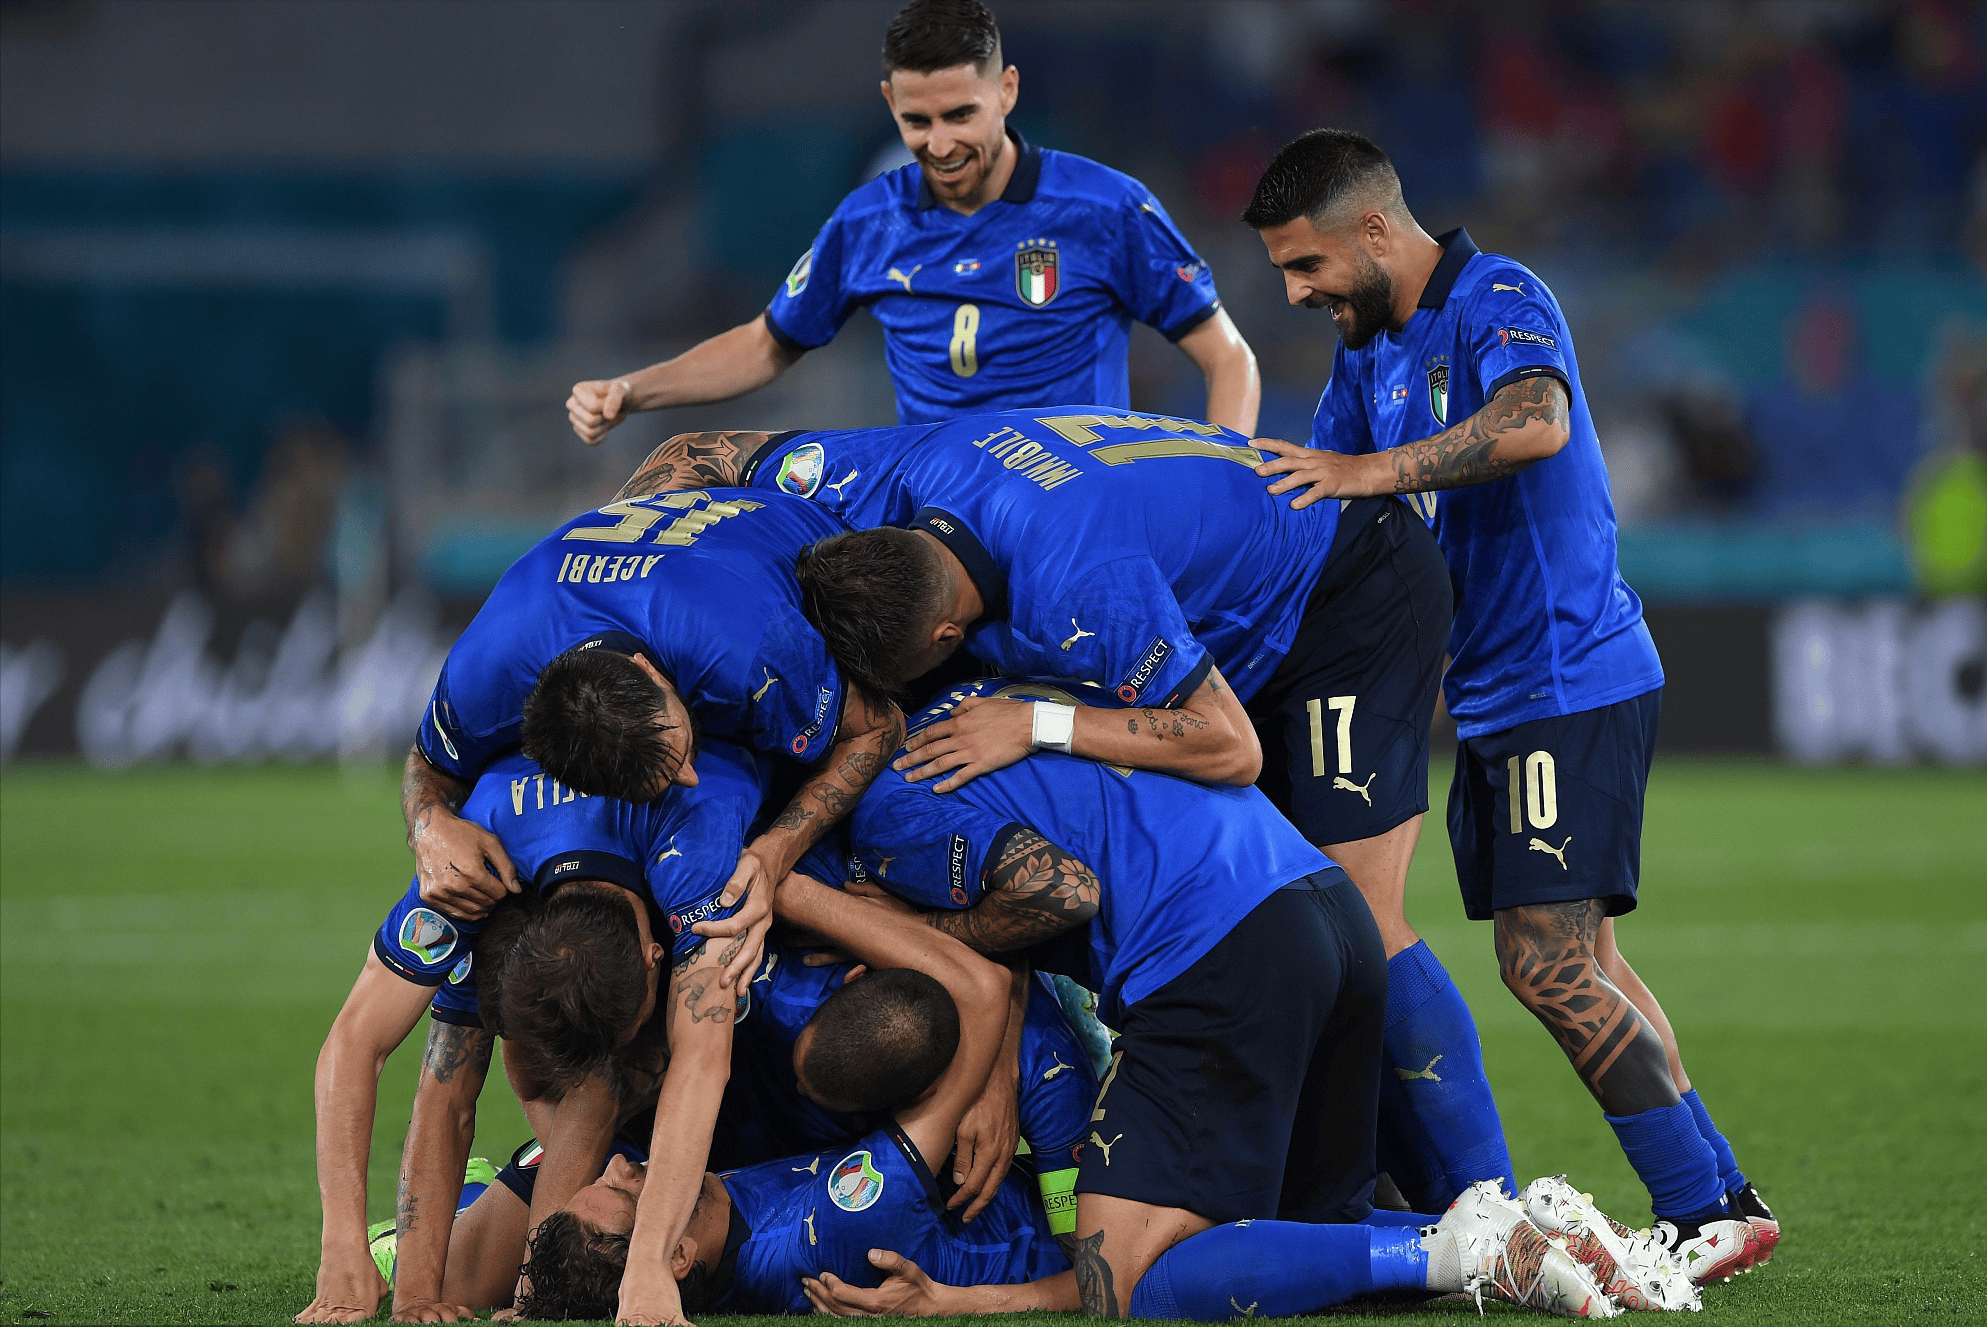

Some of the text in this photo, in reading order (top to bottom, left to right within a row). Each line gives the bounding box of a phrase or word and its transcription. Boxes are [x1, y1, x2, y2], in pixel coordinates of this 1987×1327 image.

[949, 303, 980, 378] 8
[1510, 330, 1555, 347] RESPECT
[1430, 369, 1450, 384] ITALI
[972, 426, 1084, 491] IMMOBILE
[1033, 415, 1265, 470] 17
[561, 491, 766, 546] 15
[929, 517, 955, 535] ITALIA
[557, 553, 665, 583] ACERBI
[1130, 639, 1168, 688] RESPECT
[804, 686, 831, 737] RESPECT
[1306, 695, 1358, 778] 17
[1507, 750, 1558, 835] 10
[554, 861, 580, 875] ITALIA
[952, 834, 965, 888] RESPECT
[681, 896, 721, 926] RESPEC
[1044, 1195, 1078, 1210] RESPE
